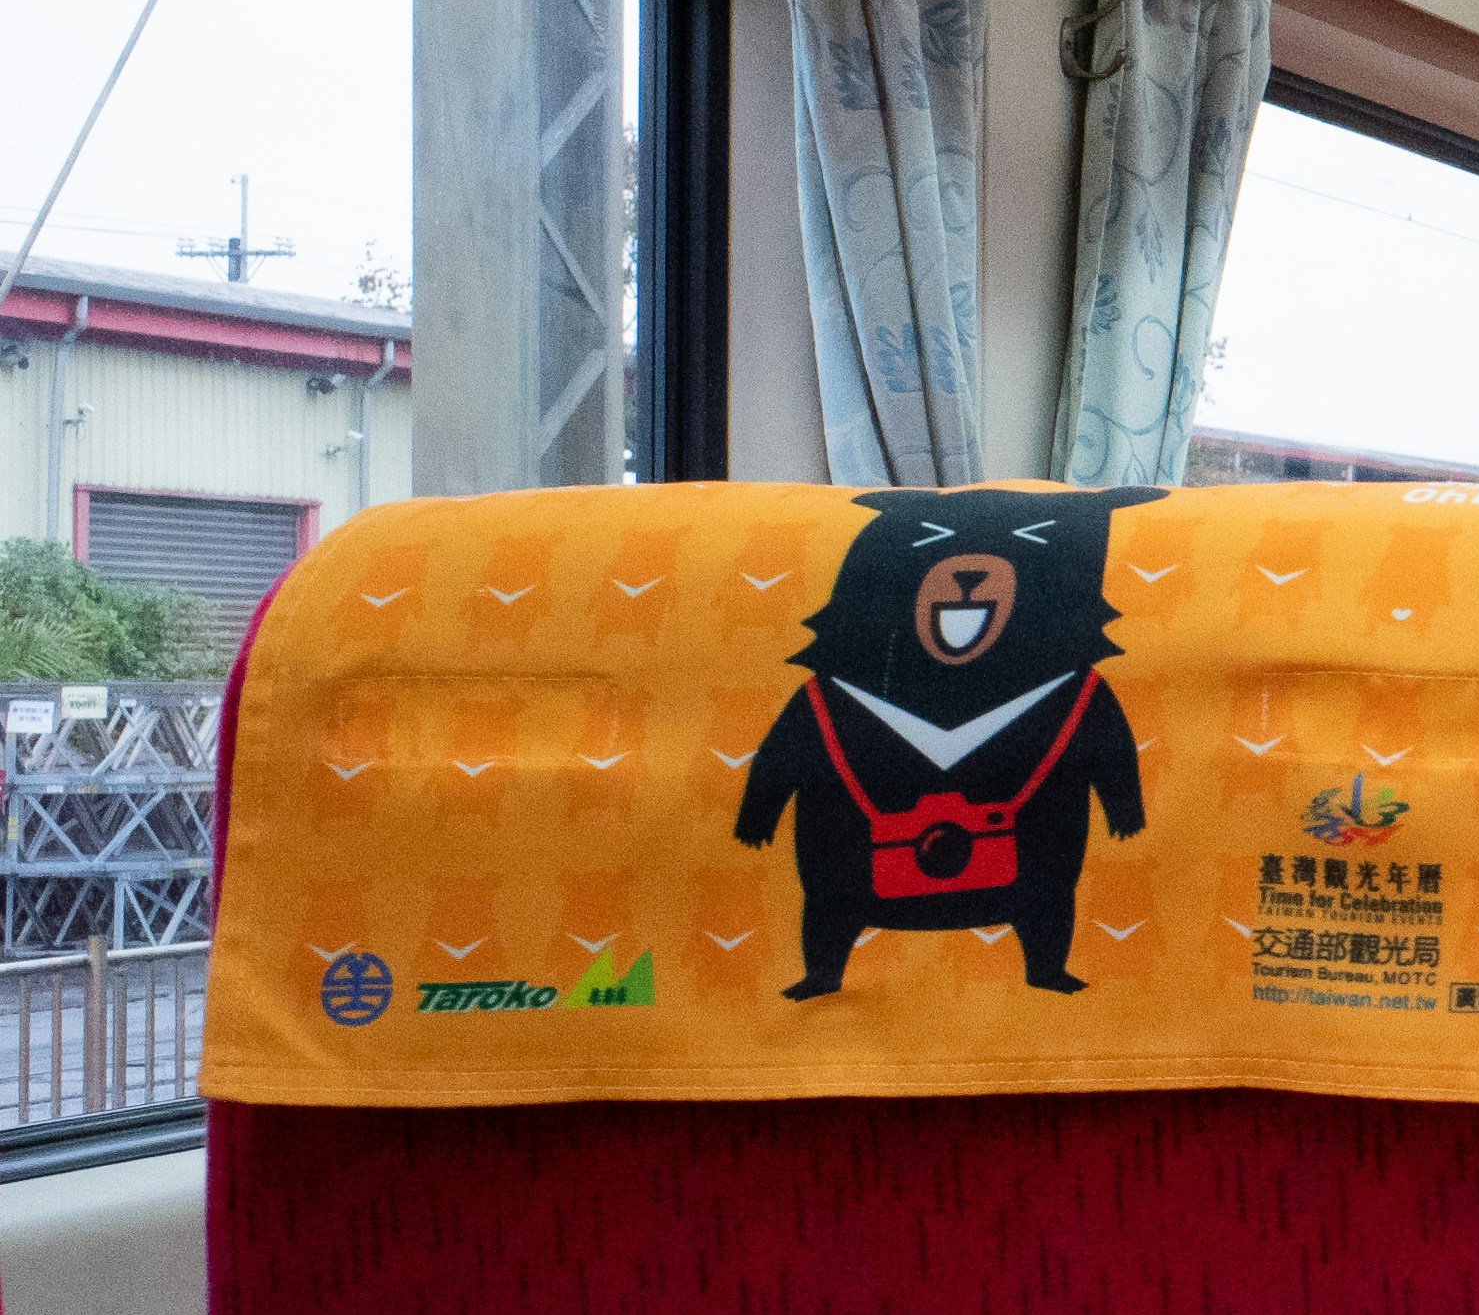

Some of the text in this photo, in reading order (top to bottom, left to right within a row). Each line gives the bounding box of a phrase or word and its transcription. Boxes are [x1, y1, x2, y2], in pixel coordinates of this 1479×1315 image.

[1258, 886, 1443, 914] Time for Celebration
[1252, 926, 1439, 968] 交通部觀光局
[1252, 962, 1313, 979] Tourism
[1383, 971, 1437, 986] MOTC
[416, 981, 558, 1012] Taroko
